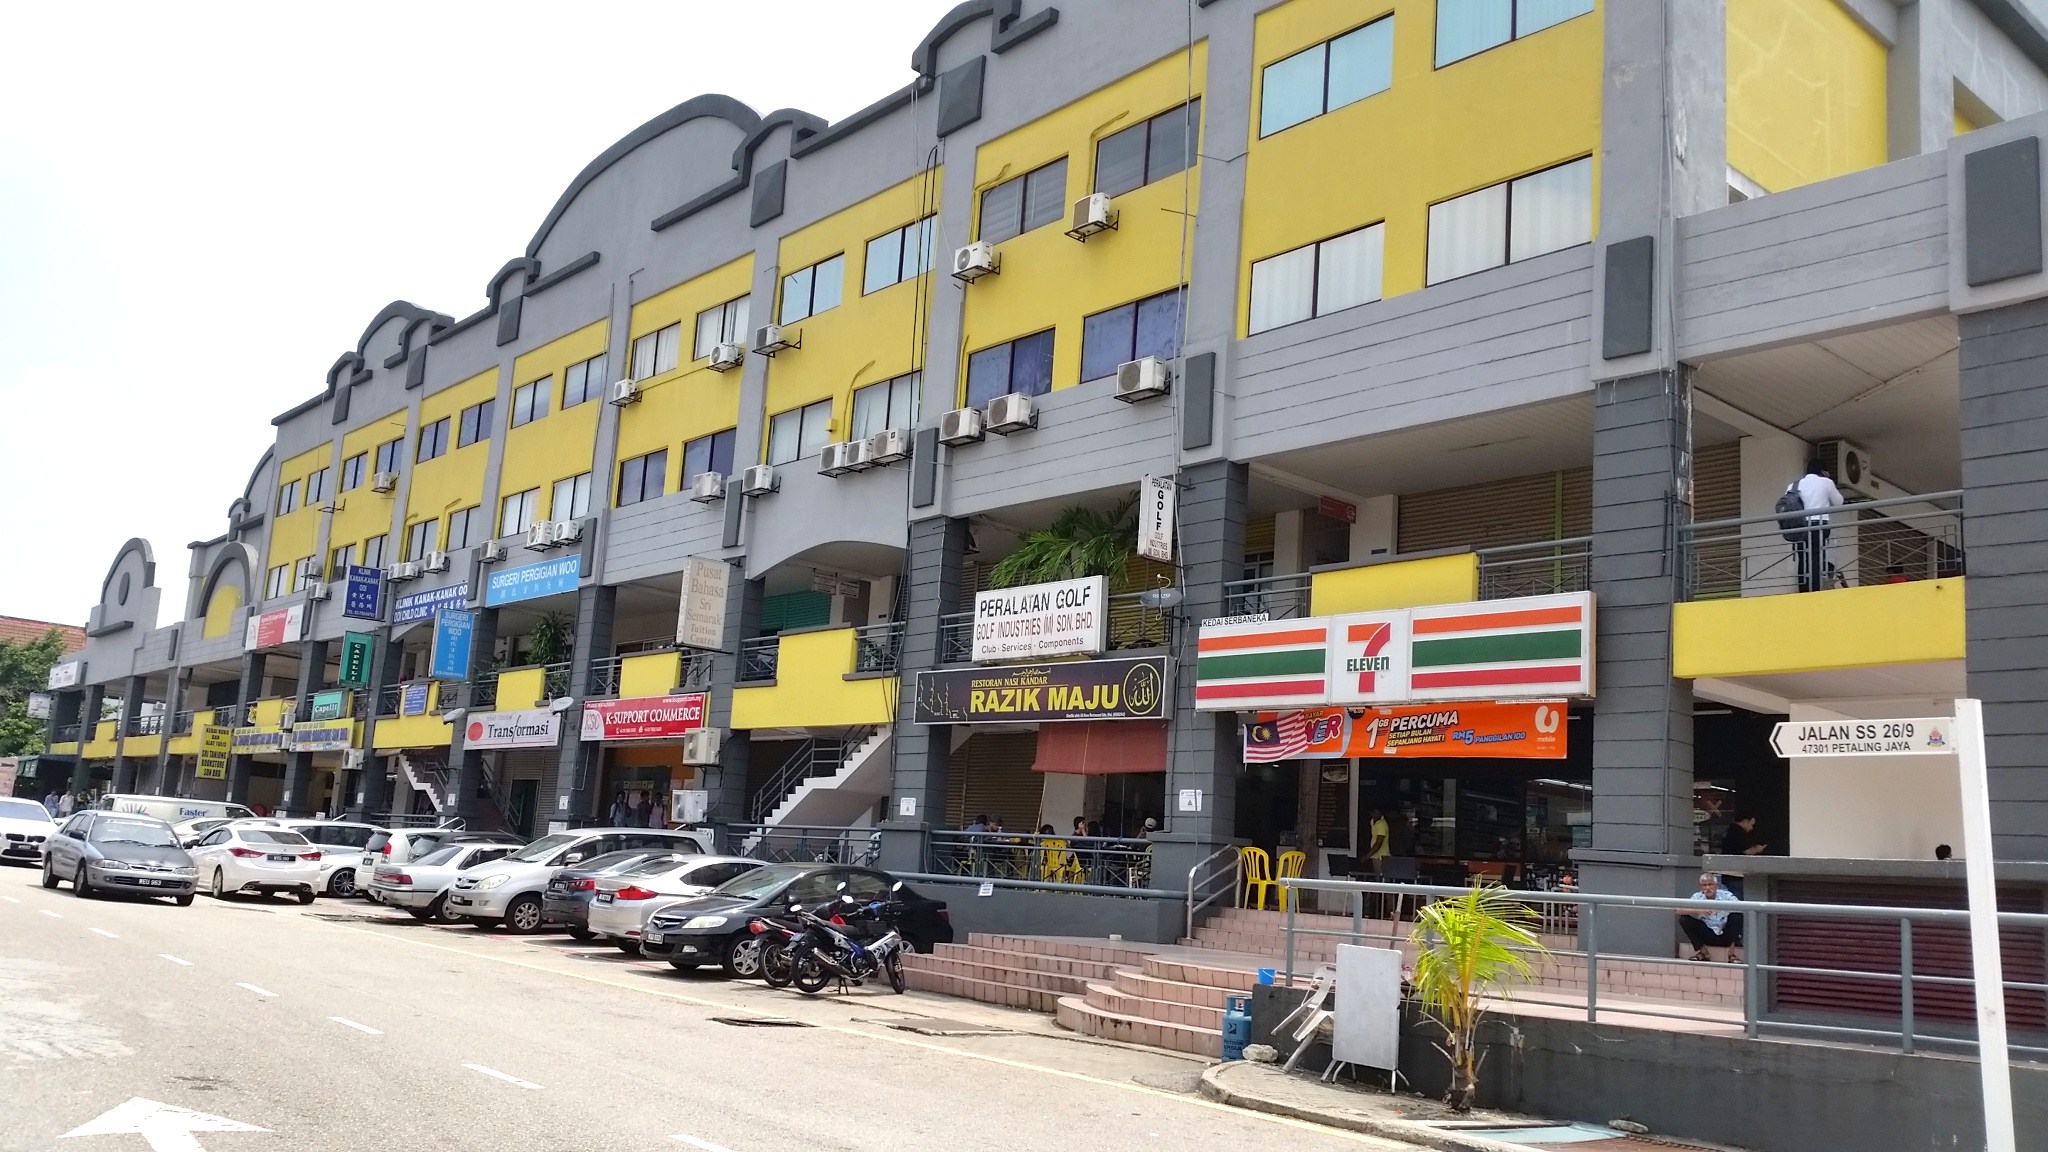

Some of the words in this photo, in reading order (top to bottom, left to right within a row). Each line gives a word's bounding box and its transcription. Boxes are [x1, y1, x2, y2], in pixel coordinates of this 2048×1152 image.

[1156, 490, 1164, 530] GOLF
[492, 573, 520, 589] SURGERI
[521, 564, 558, 583] PERGIGIAN
[559, 559, 577, 575] WOO
[697, 562, 722, 580] Pusat
[395, 597, 413, 610] KLINIK
[414, 586, 457, 606] KANAK-KANAK
[458, 584, 468, 596] OO
[691, 578, 724, 598] Bahasa
[700, 598, 712, 611] Sri
[980, 591, 1050, 619] PERALATAN
[1055, 585, 1091, 609] GOLF
[686, 609, 721, 625] Semarak
[976, 621, 995, 641] GOLF
[997, 617, 1041, 638] INDUSTRIES
[1056, 613, 1074, 632] SDN.
[1075, 611, 1093, 630] BHD.
[1202, 618, 1223, 628] KEDAI
[1224, 614, 1267, 626] SERBANEKA
[981, 644, 997, 654] Club
[1001, 641, 1032, 652] Services
[1038, 637, 1084, 649] Components
[351, 643, 361, 681] CAPELLI
[1346, 656, 1390, 672] ELEVEN
[1347, 622, 1391, 693] 7
[971, 679, 1003, 688] RESTORAN
[1004, 678, 1019, 686] NASI
[1020, 676, 1048, 685] KANDAR
[970, 688, 1041, 713] RAZIK
[1047, 684, 1119, 711] MAJU
[606, 710, 649, 724] K-SUPPORT
[650, 707, 700, 722] COMMERCE
[1390, 711, 1458, 731] PERCUMA
[488, 714, 549, 743] Transformasi
[1389, 731, 1410, 739] SETIAP
[1411, 729, 1432, 737] BULAN
[1452, 730, 1474, 744] RM5
[1475, 734, 1513, 743] PANGGILAN
[1798, 726, 1850, 741] JALAN
[1856, 725, 1877, 739] SS
[1883, 723, 1914, 738] 26/9
[1387, 737, 1422, 746] SEPANJANG
[1802, 744, 1829, 753] 47301
[1832, 742, 1882, 753] PETALING
[1885, 741, 1911, 751] JAYA
[179, 807, 208, 817] Faster
